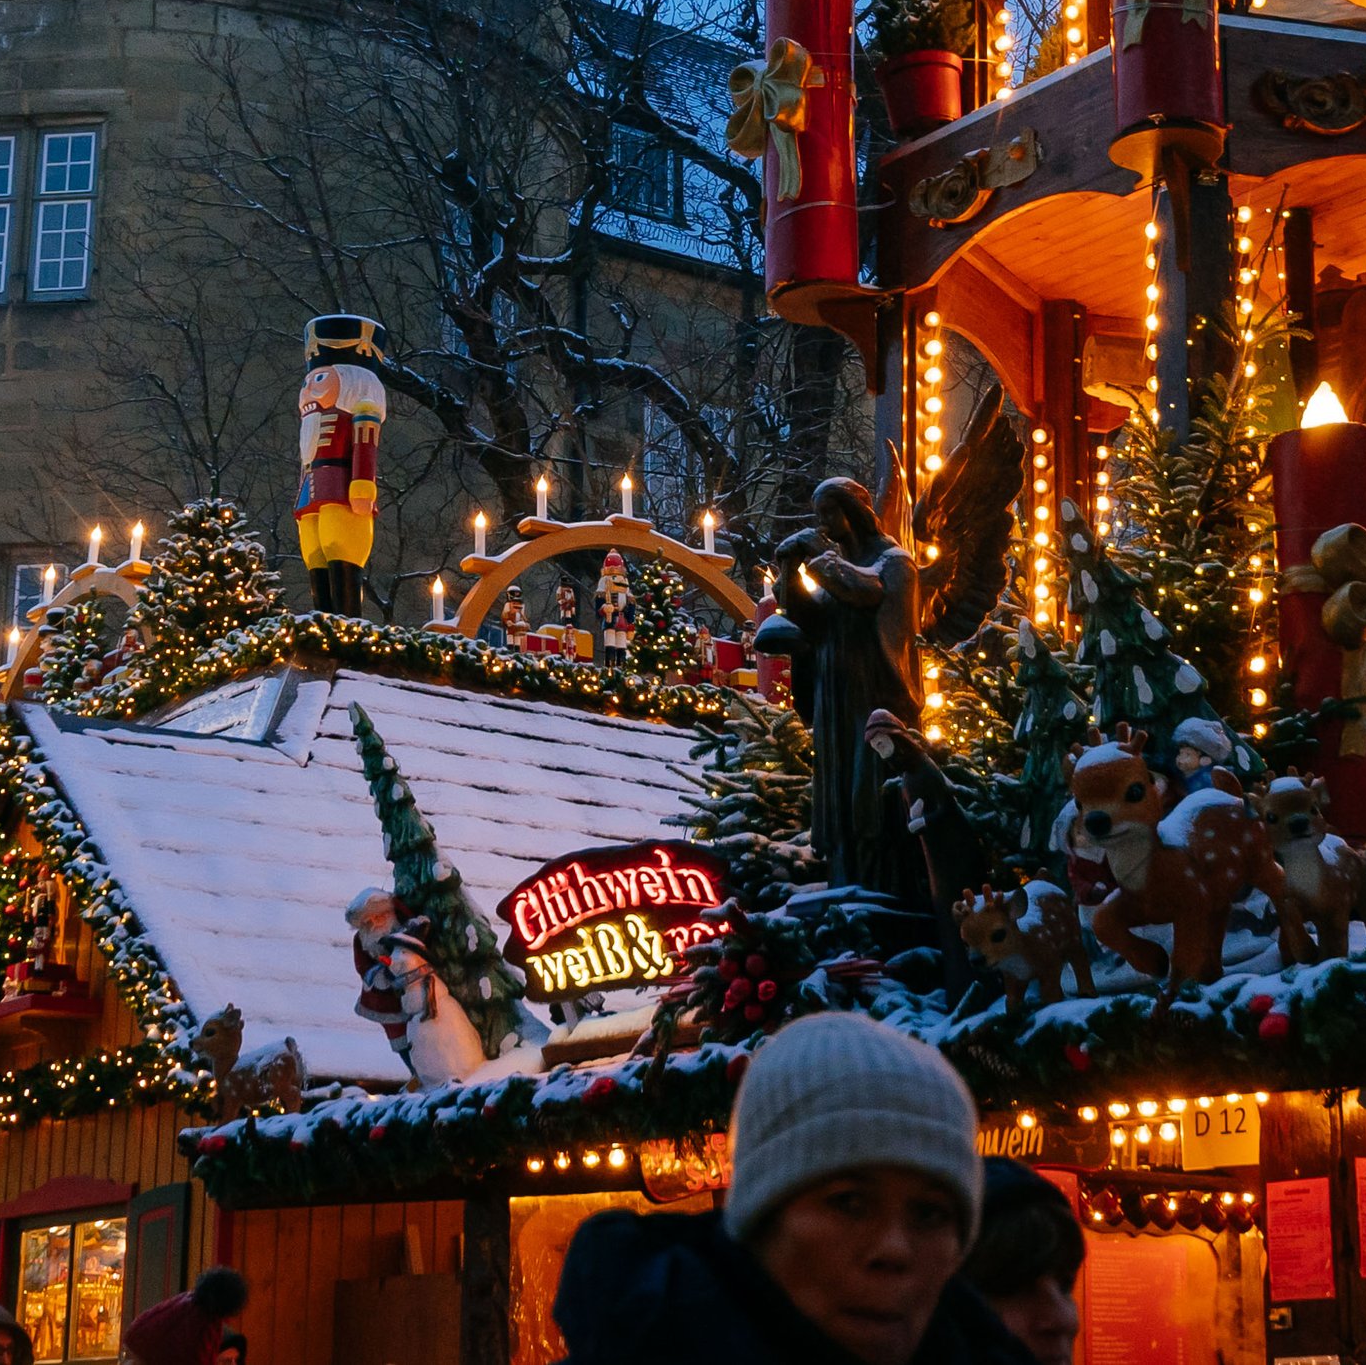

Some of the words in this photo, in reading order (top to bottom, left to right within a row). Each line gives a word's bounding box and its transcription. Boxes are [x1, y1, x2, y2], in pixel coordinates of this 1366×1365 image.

[515, 849, 720, 950] Glühwein
[526, 923, 633, 992] weiß
[625, 914, 674, 979] &
[1195, 1111, 1210, 1137] D
[1220, 1107, 1247, 1134] 12
